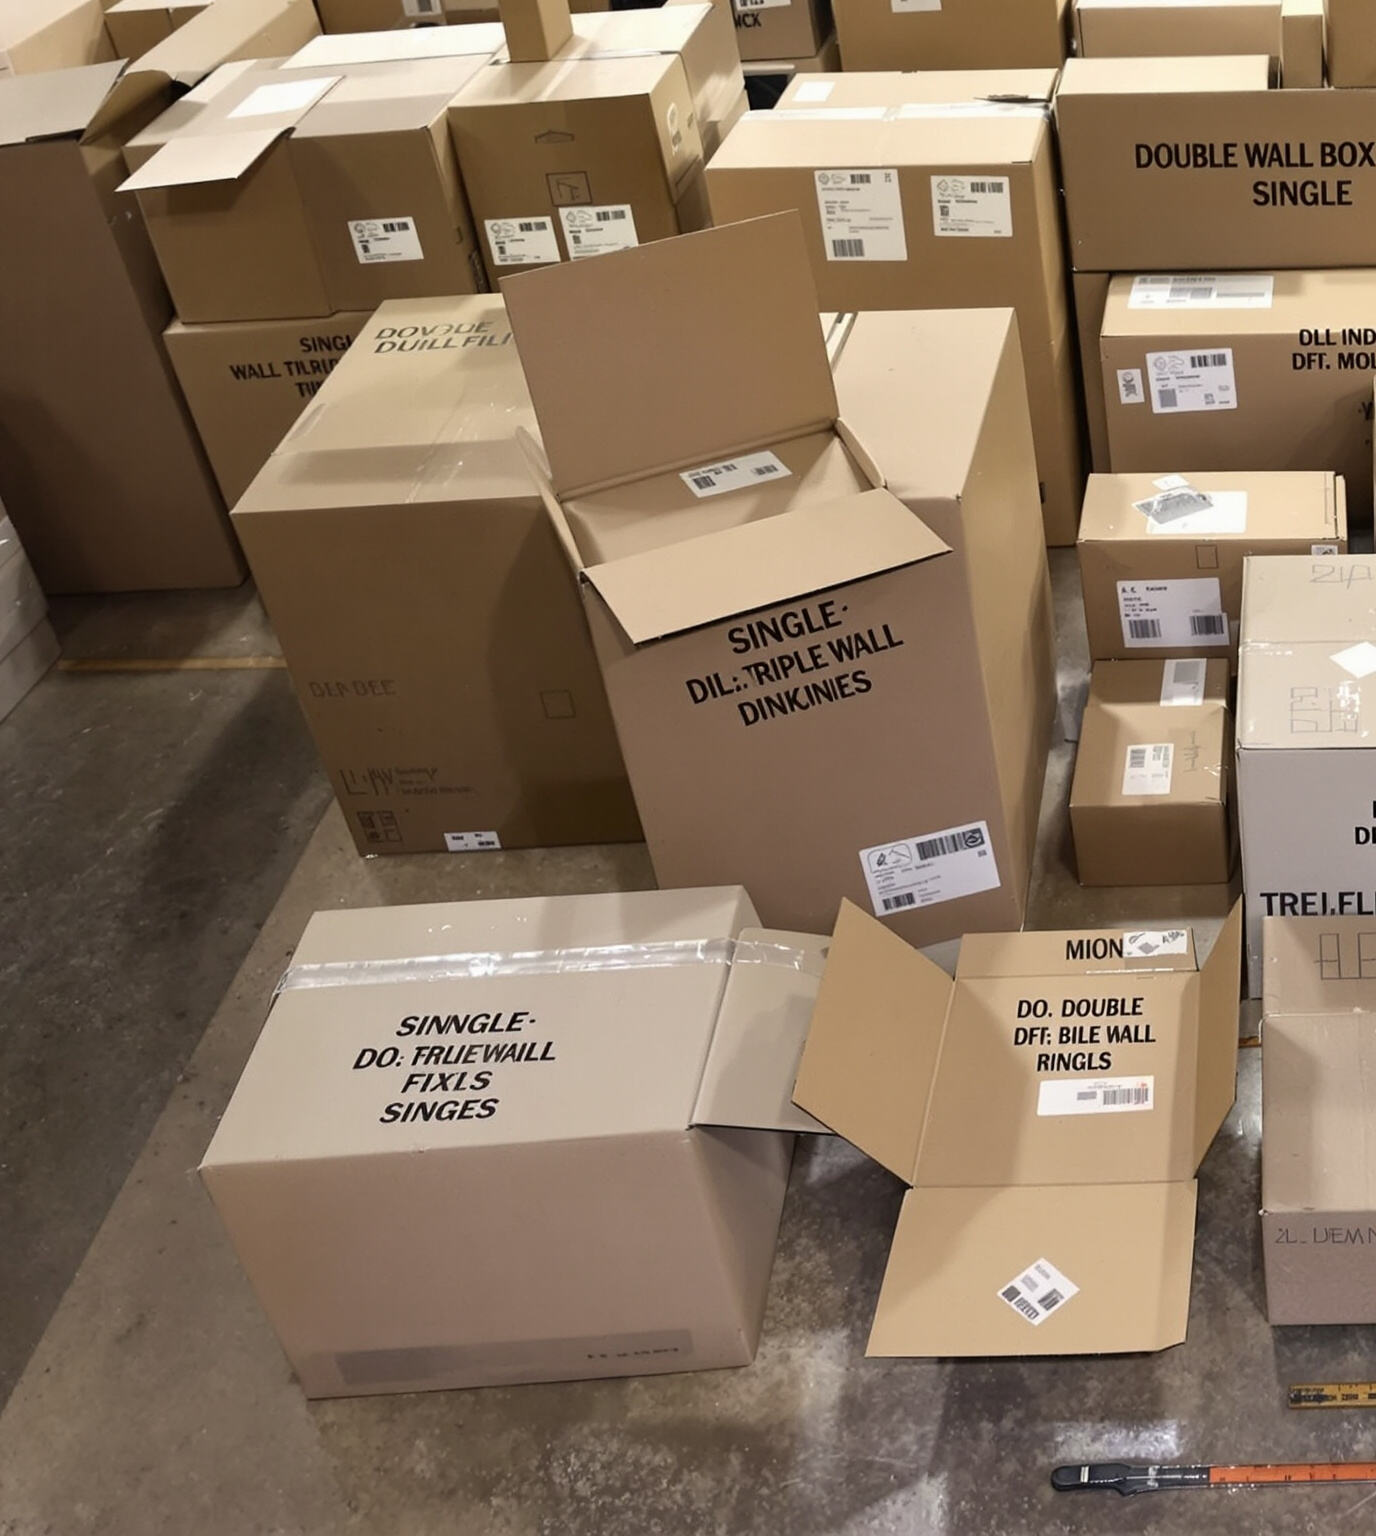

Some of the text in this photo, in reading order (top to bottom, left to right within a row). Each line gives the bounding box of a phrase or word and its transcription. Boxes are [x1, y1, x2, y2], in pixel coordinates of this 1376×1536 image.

[1135, 143, 1238, 168] DOUBLE
[1244, 142, 1314, 168] WALL
[1252, 180, 1353, 206] SINGLE
[229, 363, 281, 381] WALL
[826, 624, 904, 663] WALL
[1061, 997, 1144, 1018] DOUBLE
[1058, 1025, 1101, 1045] BILE
[1106, 1024, 1156, 1043] WALL
[1036, 1051, 1112, 1072] RINGLS
[379, 1098, 500, 1124] SINGES
